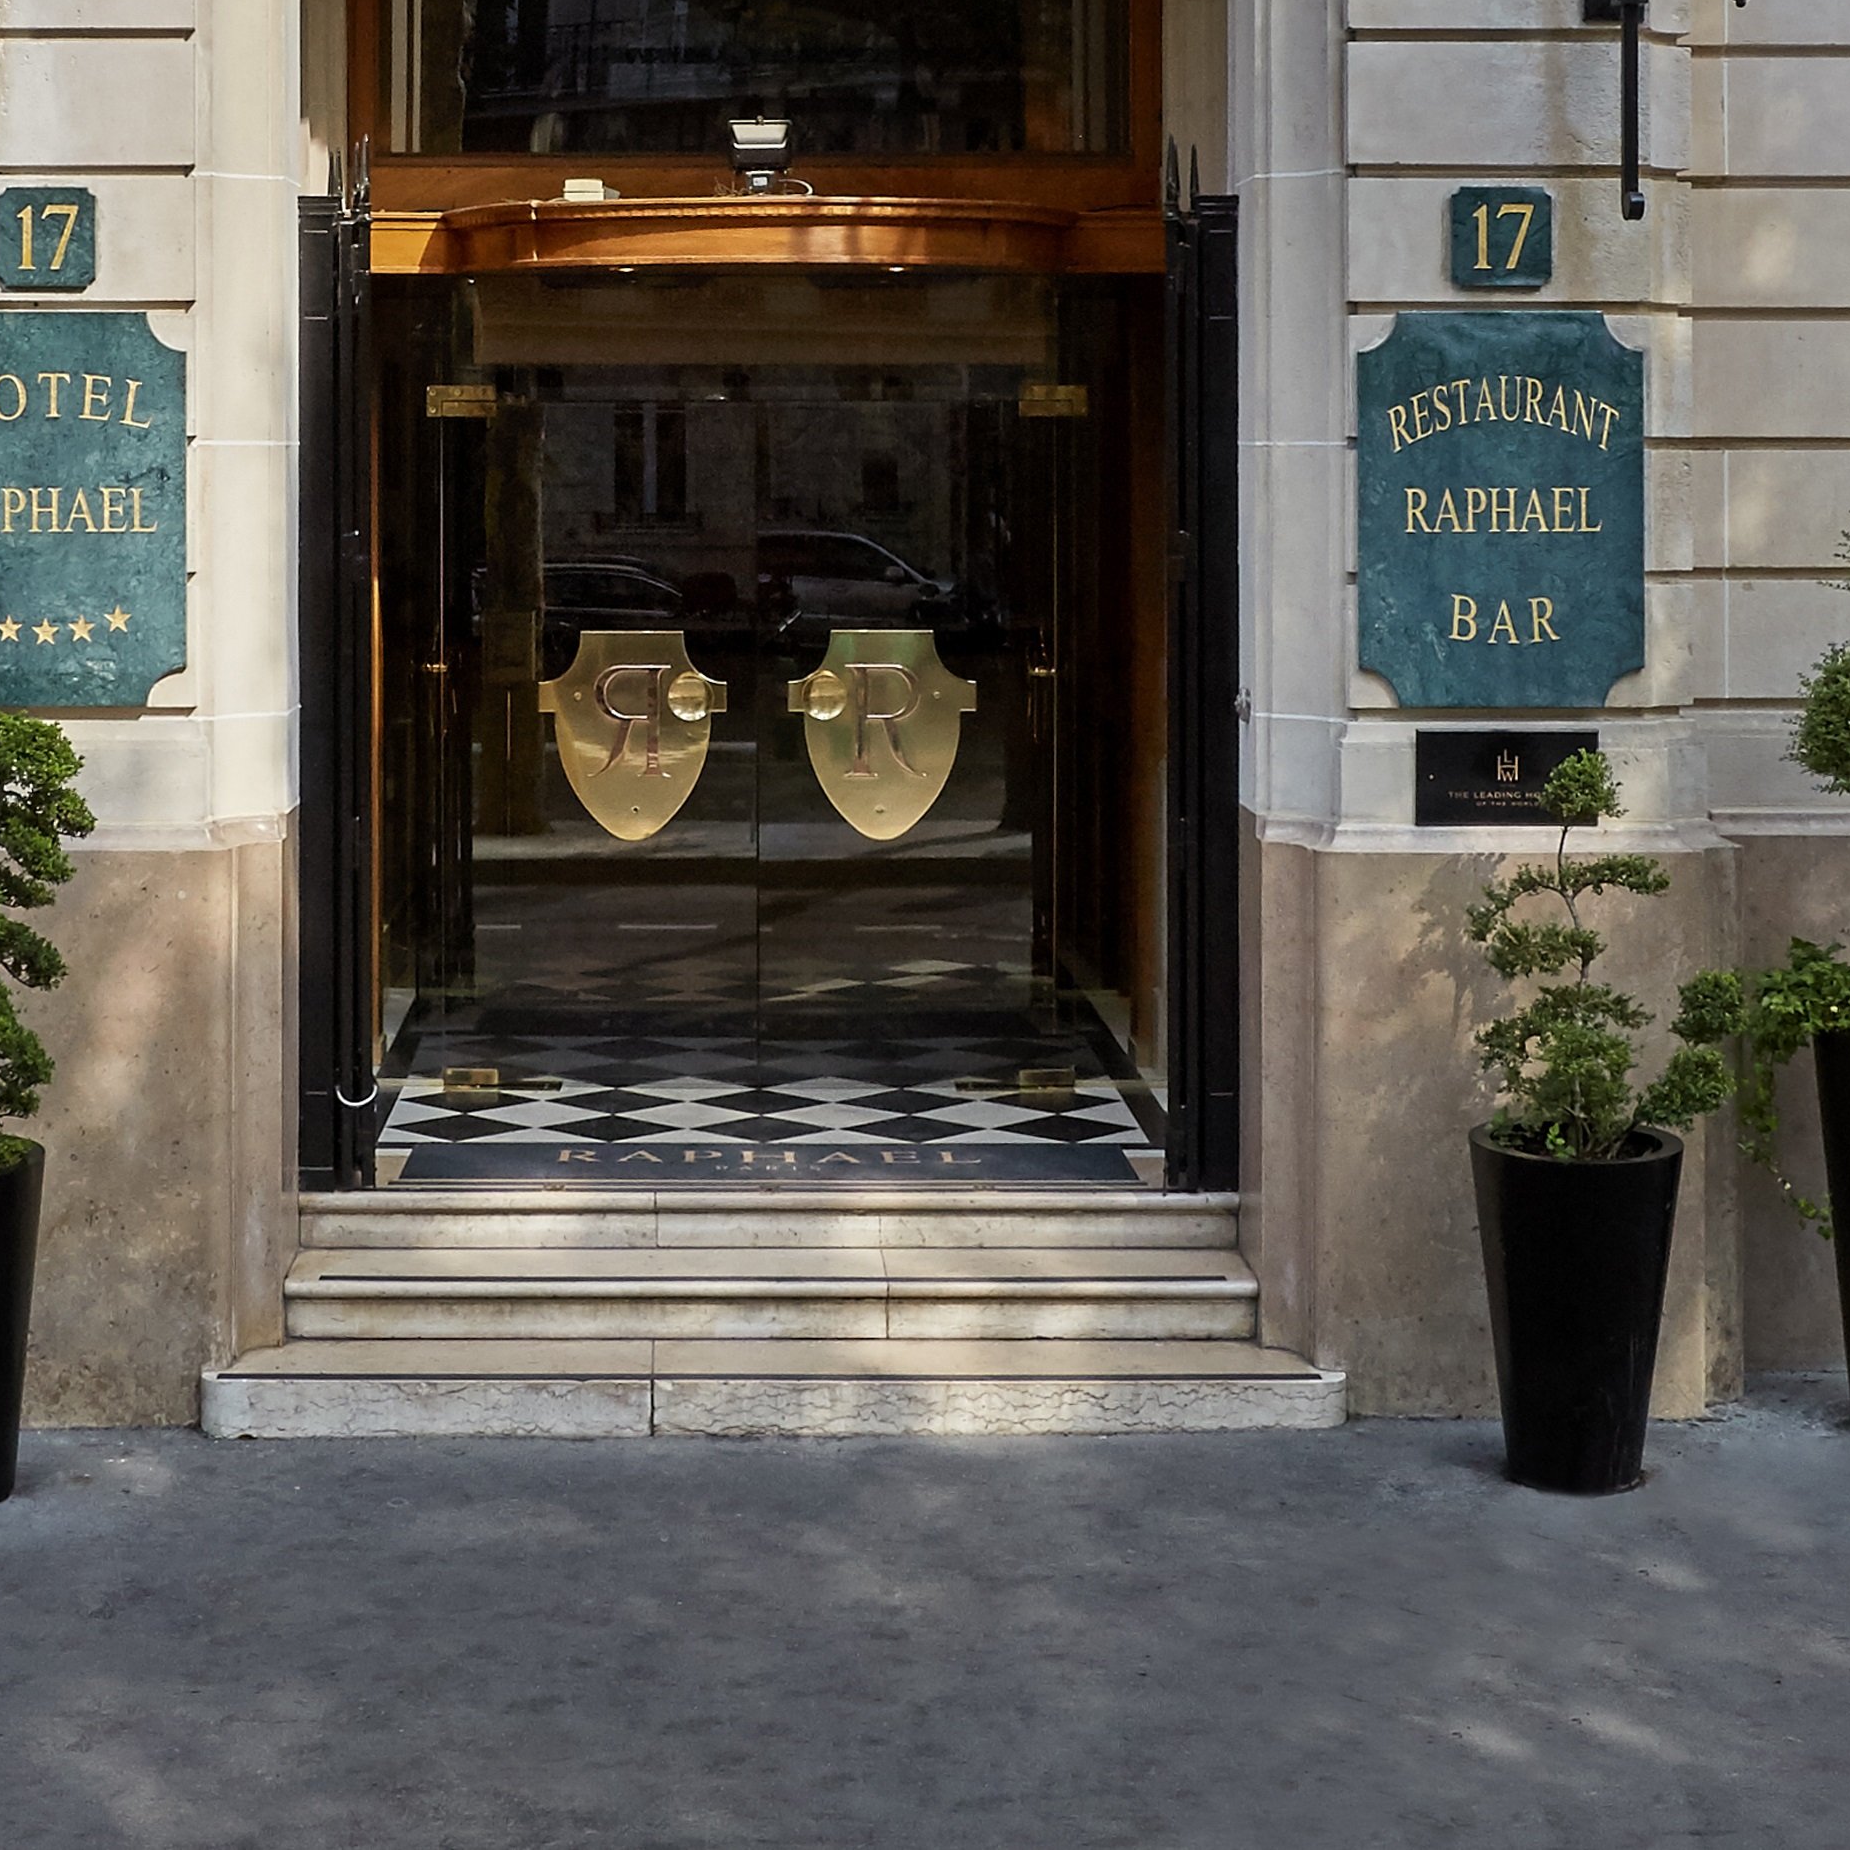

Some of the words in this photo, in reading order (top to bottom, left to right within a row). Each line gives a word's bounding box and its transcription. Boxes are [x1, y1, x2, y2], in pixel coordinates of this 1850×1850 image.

[15, 203, 80, 271] 17
[1471, 203, 1536, 271] 17
[1385, 373, 1621, 453] RESTAURANT
[1404, 485, 1603, 535] RAPHAEL
[1448, 592, 1561, 646] BAR
[844, 662, 928, 779] R
[1448, 791, 1469, 799] THE
[1473, 791, 1522, 799] LEADING
[556, 1149, 982, 1165] RAPHAEL
